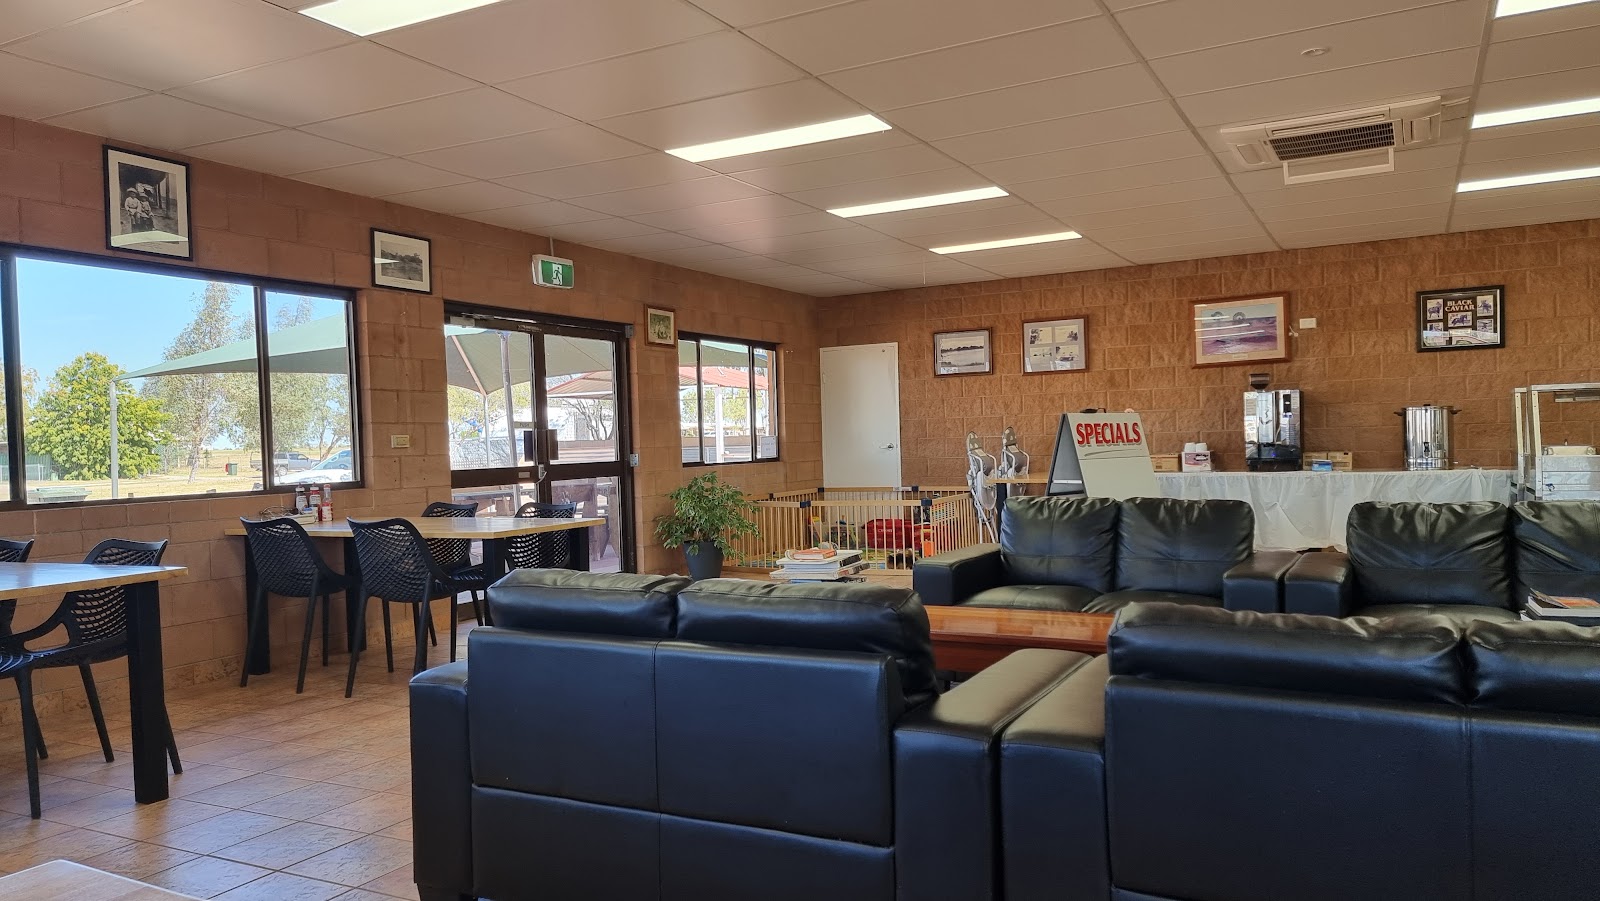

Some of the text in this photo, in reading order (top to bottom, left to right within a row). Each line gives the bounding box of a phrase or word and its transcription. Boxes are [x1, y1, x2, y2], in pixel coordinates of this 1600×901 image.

[1447, 299, 1473, 307] BLACK
[1445, 304, 1475, 312] CAVIAR
[1076, 422, 1142, 446] SPECIALS
